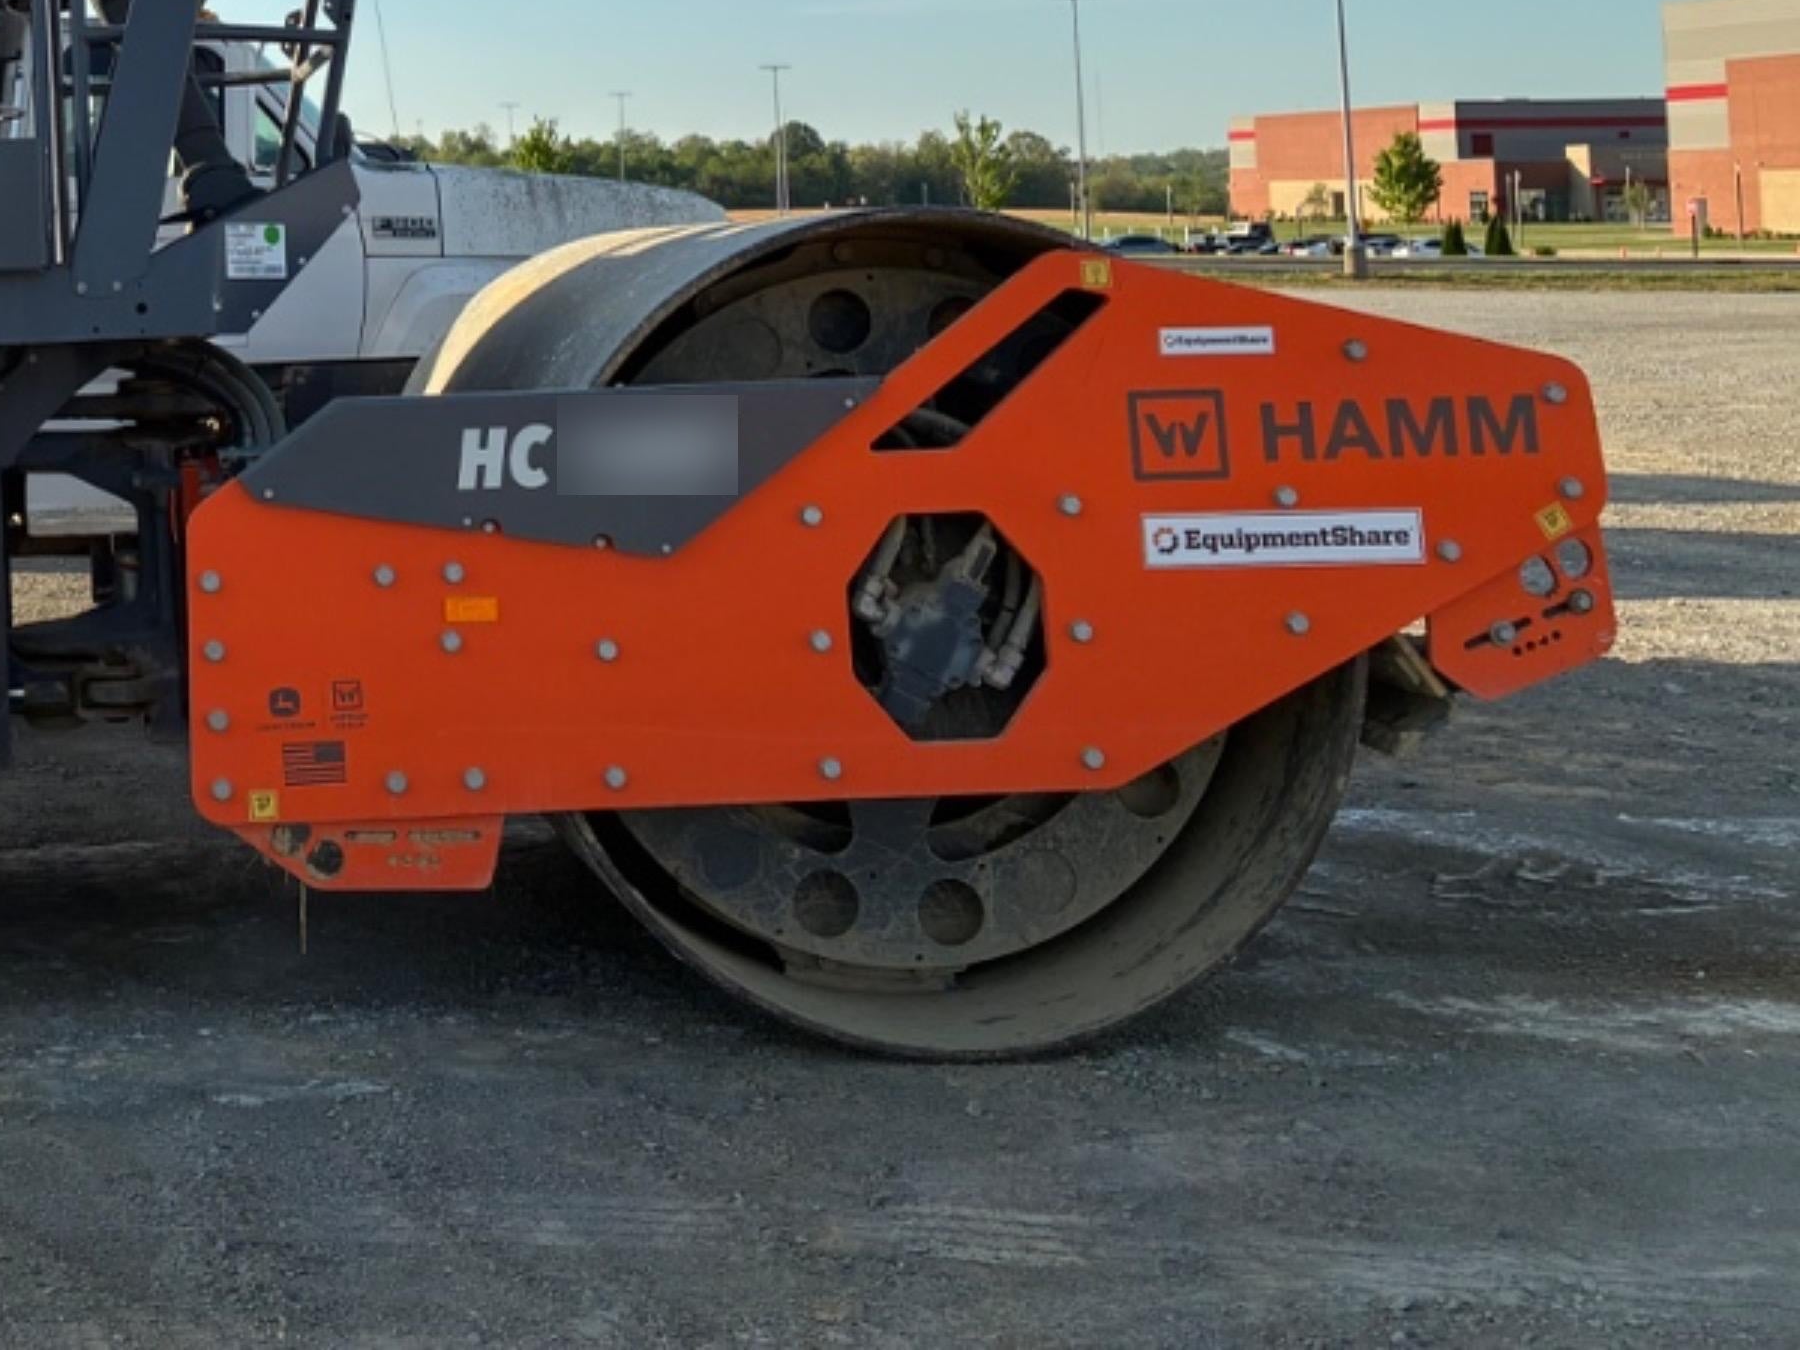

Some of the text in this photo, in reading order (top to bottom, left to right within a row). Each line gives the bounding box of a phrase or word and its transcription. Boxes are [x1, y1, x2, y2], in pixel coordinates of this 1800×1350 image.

[457, 423, 554, 491] HC
[1260, 395, 1540, 462] HAMM
[1184, 525, 1410, 554] EquipmentShare
